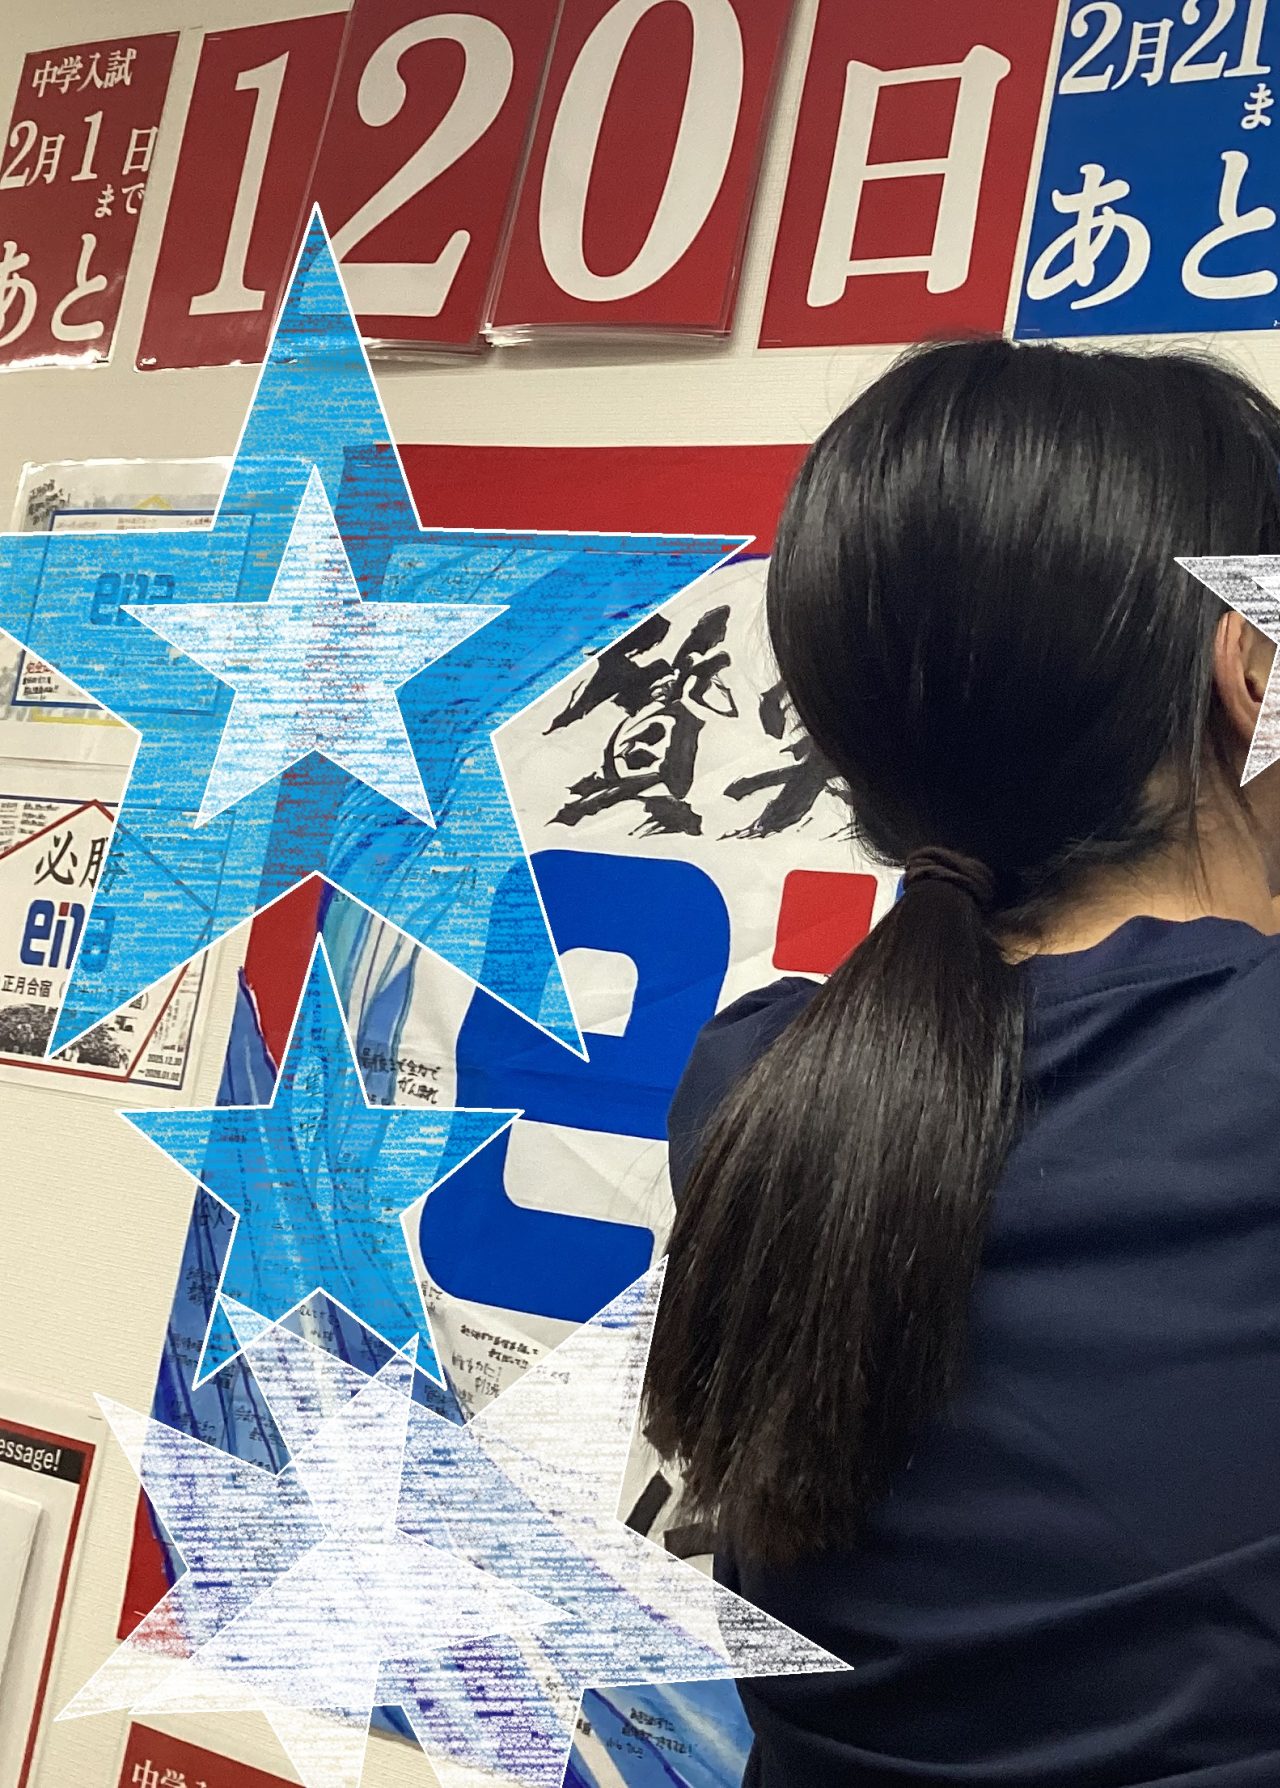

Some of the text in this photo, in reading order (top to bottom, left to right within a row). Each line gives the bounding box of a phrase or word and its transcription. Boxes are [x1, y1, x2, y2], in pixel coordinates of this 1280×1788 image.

[32, 48, 137, 98] 中学入試
[0, 110, 159, 190] 2月1日
[94, 183, 146, 218] まで
[0, 1438, 62, 1472] essage!
